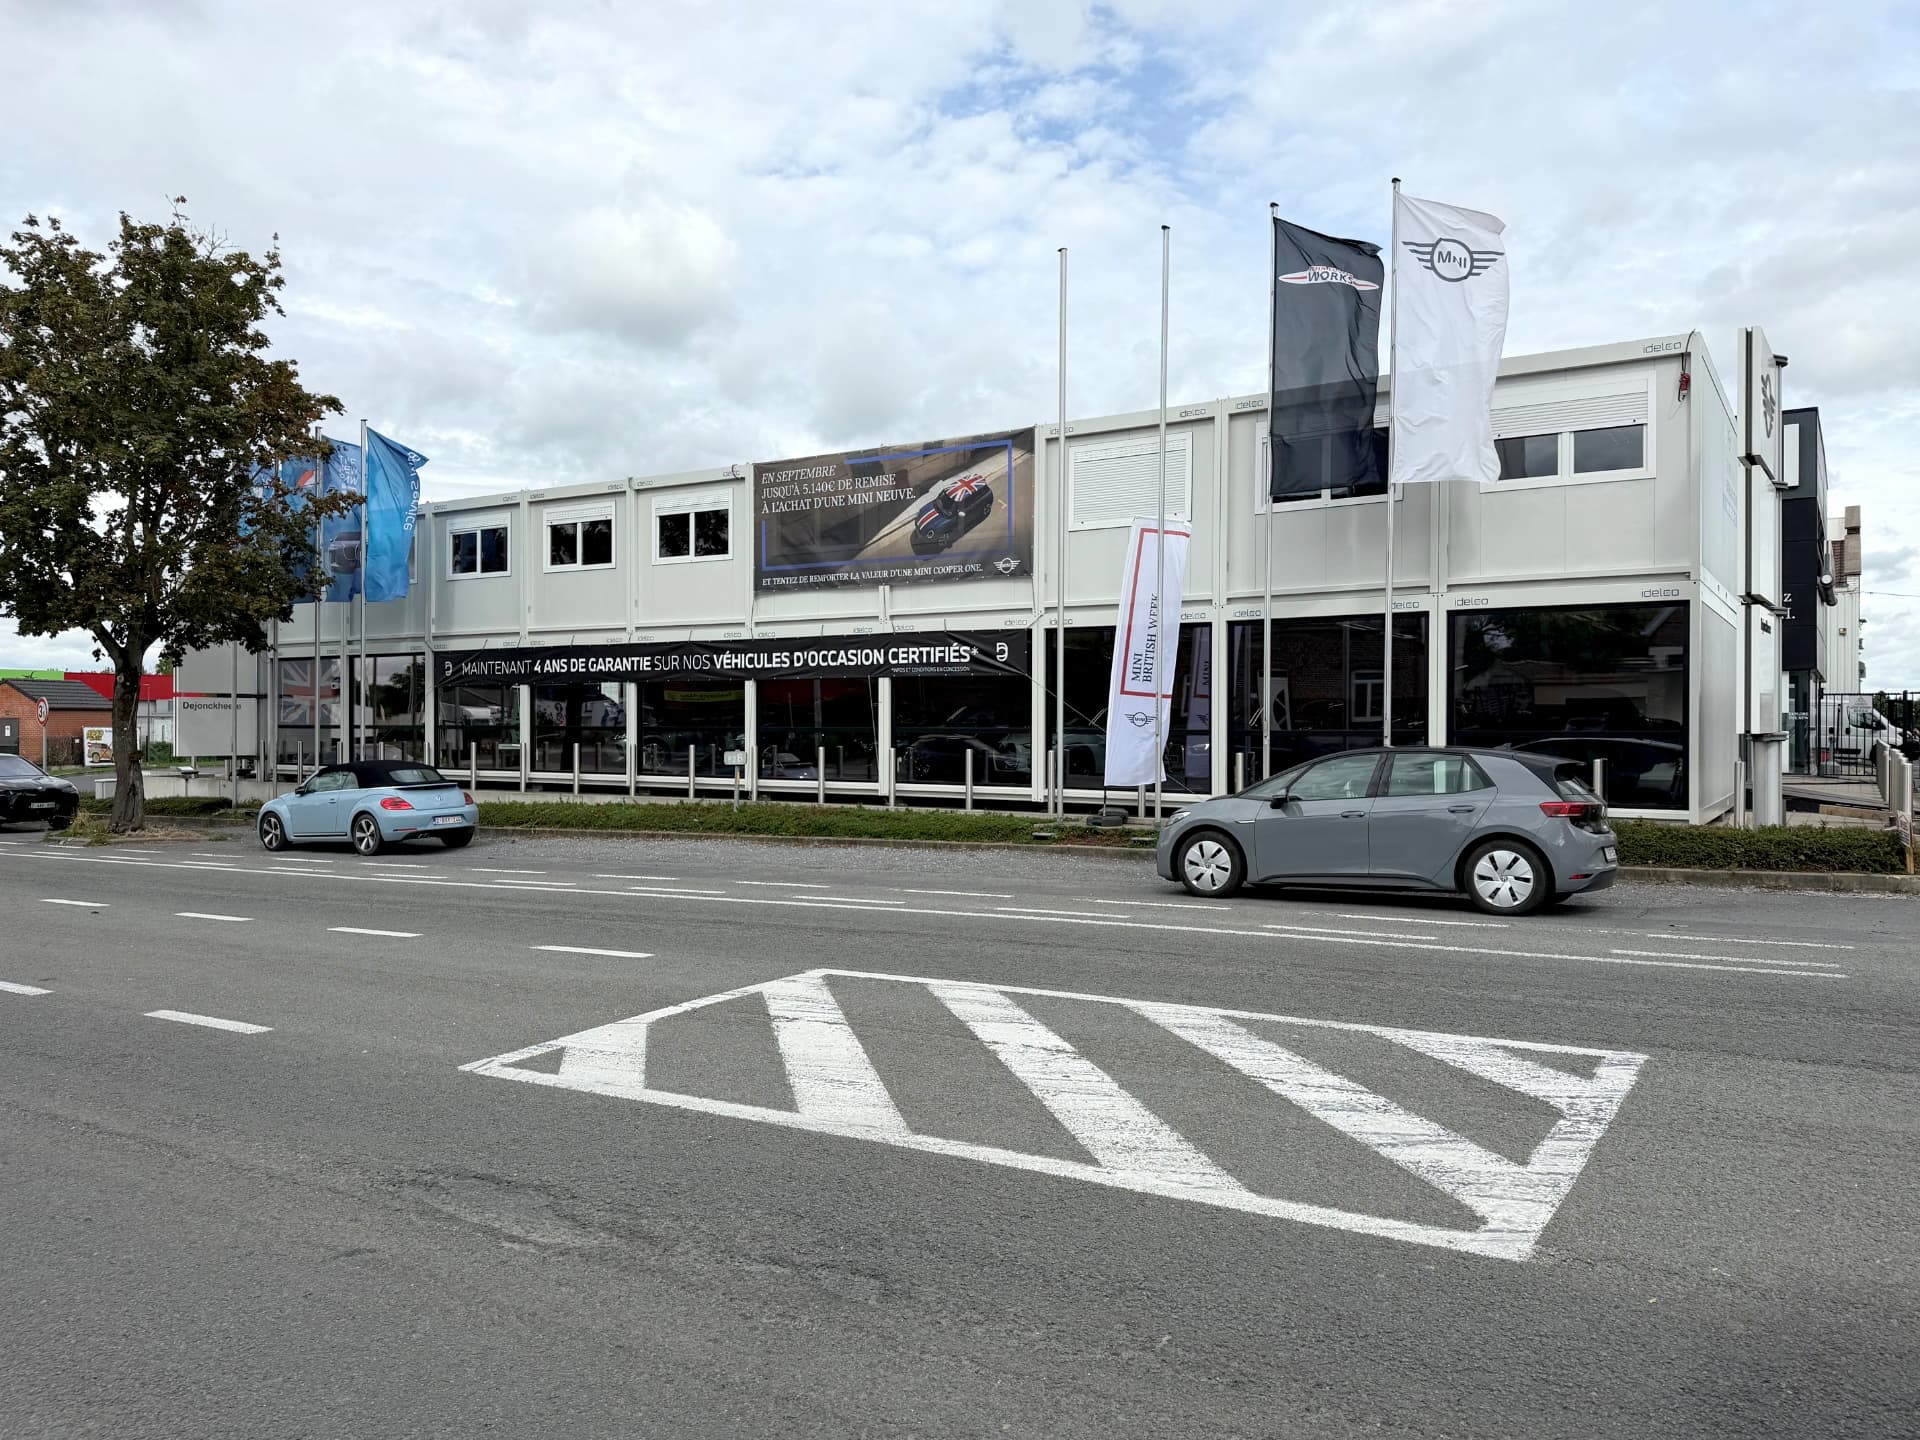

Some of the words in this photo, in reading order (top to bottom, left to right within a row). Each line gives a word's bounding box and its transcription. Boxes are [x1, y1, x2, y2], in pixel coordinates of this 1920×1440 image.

[1307, 270, 1354, 285] WORKS
[1642, 341, 1682, 354] idelco
[1179, 407, 1207, 418] idelco
[761, 472, 775, 485] EN
[776, 464, 837, 483] SEPTEMBRE
[761, 482, 800, 499] JUSQU'À
[802, 480, 836, 495] 5.140€
[838, 479, 853, 491] DE
[855, 473, 897, 489] REMISE
[403, 480, 420, 531] Service
[761, 500, 770, 514] À
[771, 498, 813, 514] L'ACHAT
[814, 495, 846, 509] D'UNE
[847, 491, 874, 506] MINI
[876, 487, 916, 503] NEUVE.
[762, 578, 772, 586] ET
[772, 576, 798, 585] TENTEZ
[809, 572, 849, 583] REMPORTER
[850, 572, 860, 580] LA
[861, 570, 888, 580] VALEUR
[890, 568, 913, 577] D'UNE
[913, 567, 932, 576] MINI
[933, 565, 965, 574] COOPER
[965, 563, 984, 572] ONE.
[1641, 587, 1680, 598] idelco
[1391, 600, 1420, 610] delco
[1454, 597, 1489, 607] idelco
[1180, 610, 1207, 621] delco
[1233, 608, 1262, 618] idelco
[462, 659, 533, 676] MAINTENANT
[533, 659, 541, 673] 4
[543, 658, 568, 673] ANS
[570, 658, 586, 672] DE
[589, 656, 652, 672] GARANTIE
[654, 655, 680, 671] SUR
[683, 654, 711, 670] NOS
[713, 650, 790, 669] VÉHICULES
[794, 648, 884, 667] D'OCCASION
[1141, 633, 1158, 683] BRITISH
[1131, 652, 1144, 682] MINI
[182, 701, 242, 712] Dejonckheee
